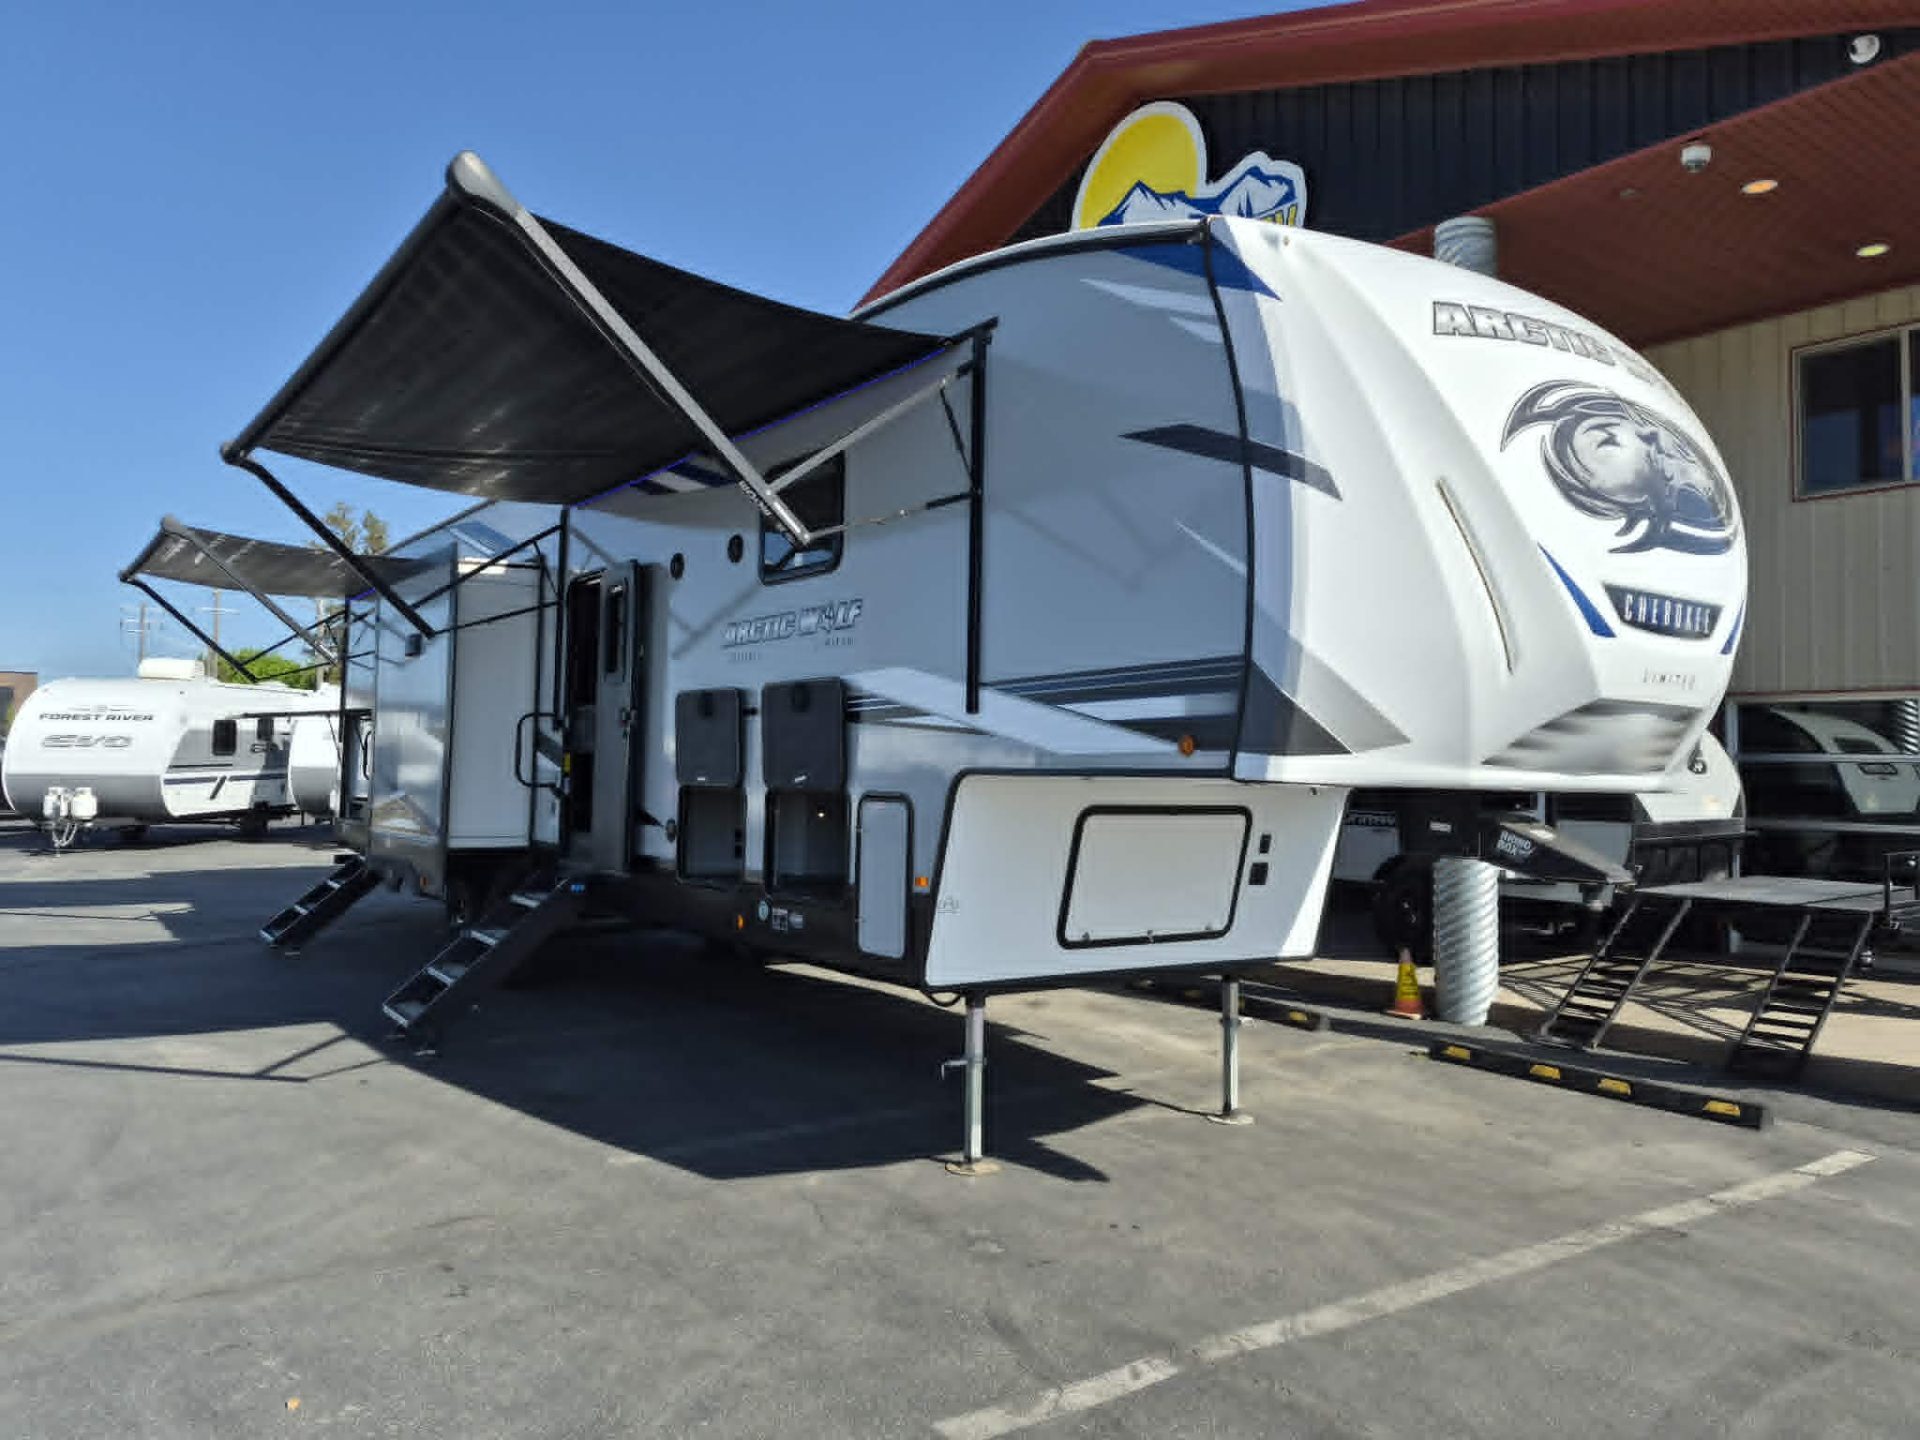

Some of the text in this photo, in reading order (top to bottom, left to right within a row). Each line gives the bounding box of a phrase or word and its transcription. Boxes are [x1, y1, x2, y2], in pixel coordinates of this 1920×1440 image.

[1433, 301, 1616, 366] ARCTIC
[1624, 593, 1711, 635] CHEROKEE
[39, 713, 154, 722] FOREST RIVER
